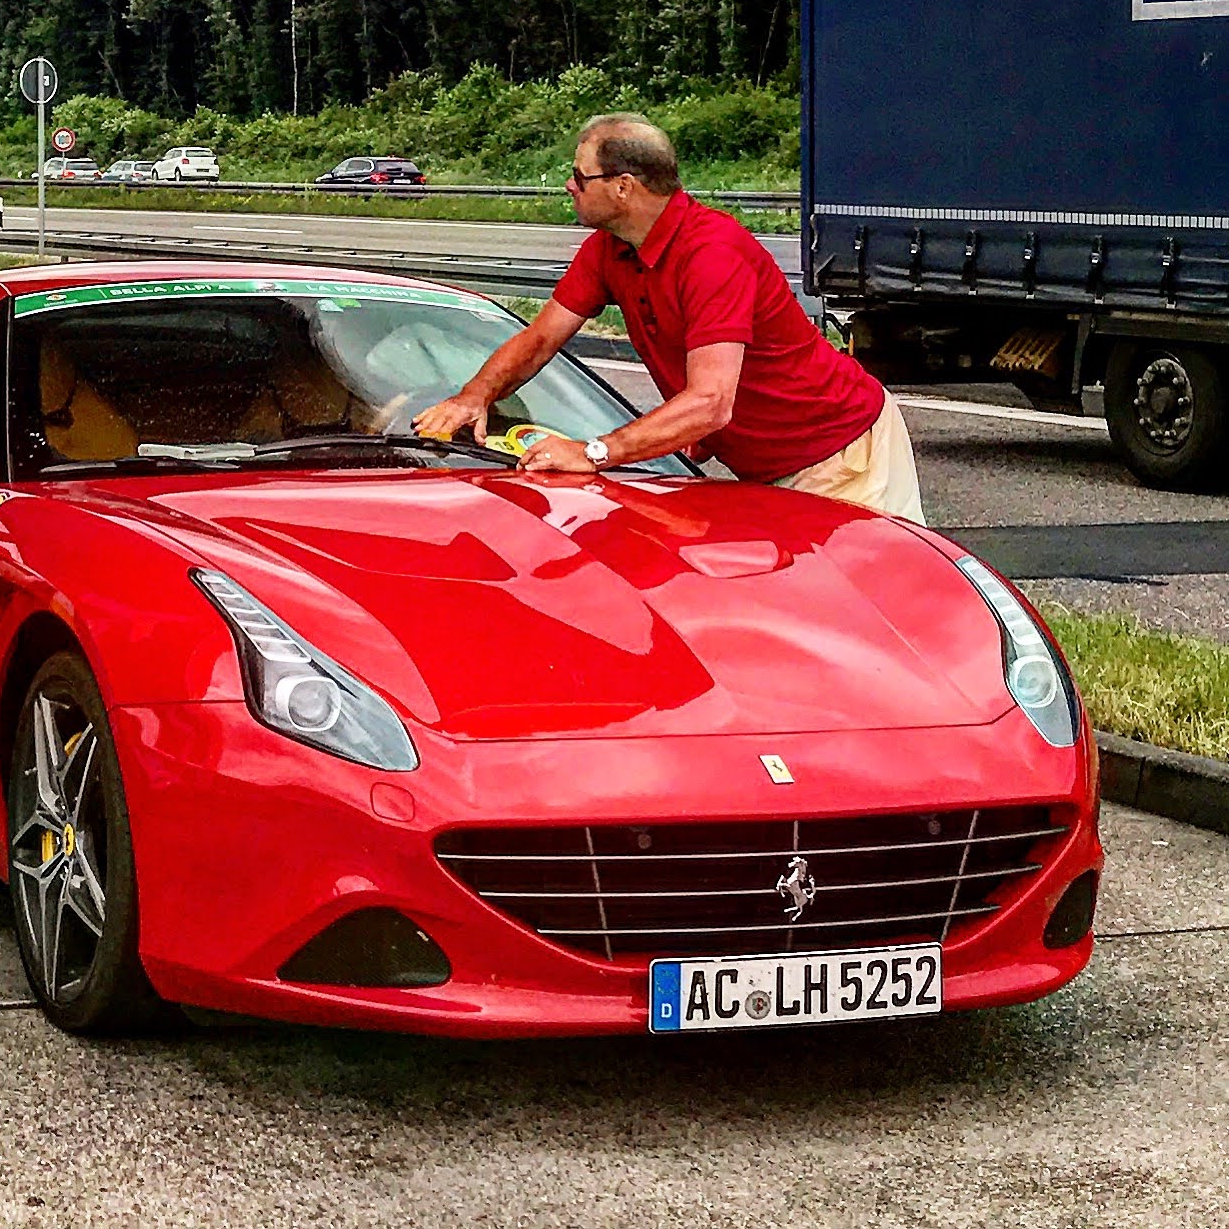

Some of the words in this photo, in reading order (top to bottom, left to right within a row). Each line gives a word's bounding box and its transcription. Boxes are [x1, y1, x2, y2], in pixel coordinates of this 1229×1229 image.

[109, 286, 168, 296] BELLA
[685, 969, 740, 1021] AC
[660, 1003, 673, 1019] D
